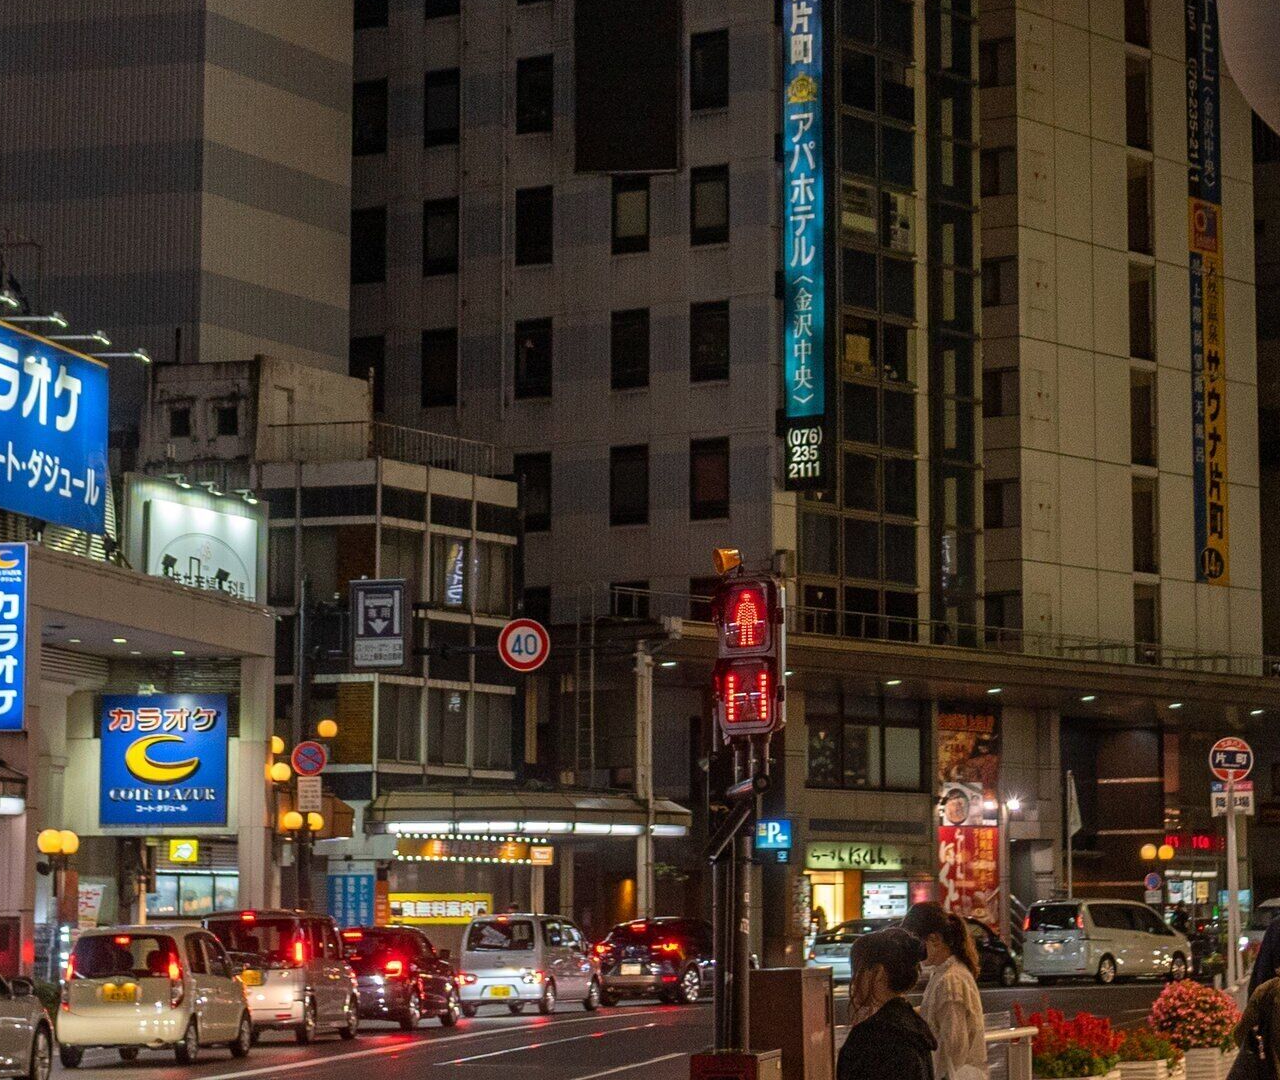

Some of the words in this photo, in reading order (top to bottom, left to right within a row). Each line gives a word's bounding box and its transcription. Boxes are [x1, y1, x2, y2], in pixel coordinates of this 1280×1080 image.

[789, 112, 816, 267] アパホテル
[787, 427, 823, 447] (076)
[791, 446, 820, 462] 235
[788, 461, 822, 479] 2111
[511, 633, 538, 656] 40
[108, 706, 218, 733] カラオケ
[1215, 752, 1248, 765] 片町
[109, 787, 154, 802] COTE
[767, 822, 781, 844] P
